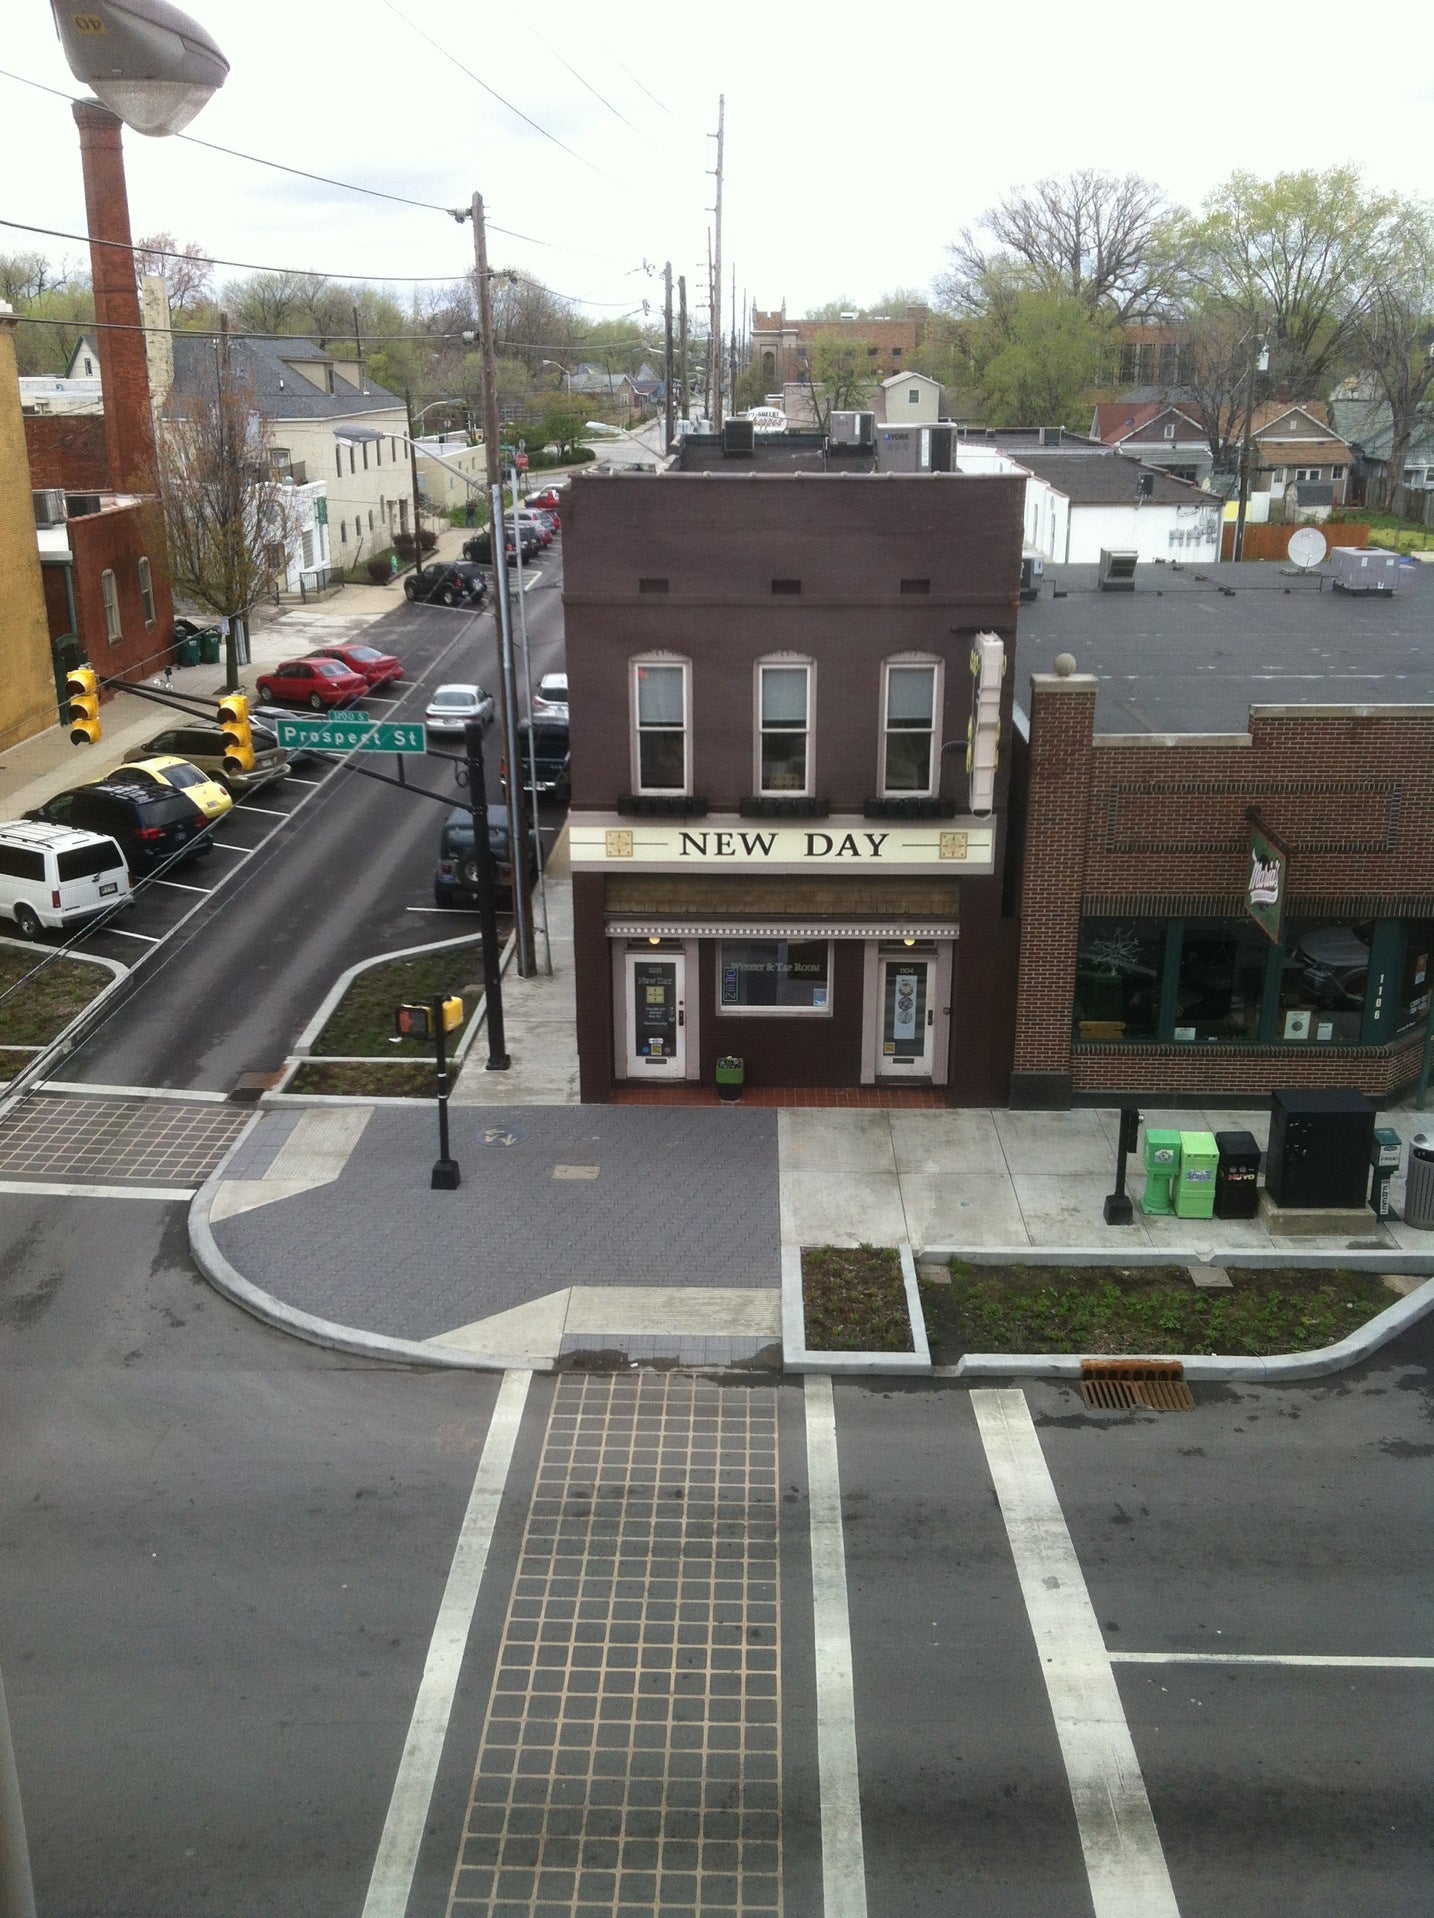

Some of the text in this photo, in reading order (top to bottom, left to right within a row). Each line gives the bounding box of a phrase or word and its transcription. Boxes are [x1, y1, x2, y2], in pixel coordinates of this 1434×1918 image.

[284, 726, 417, 746] Prospect St
[679, 832, 890, 857] NEW DAY
[794, 963, 821, 972] ROOM
[1374, 974, 1385, 1020] 1106
